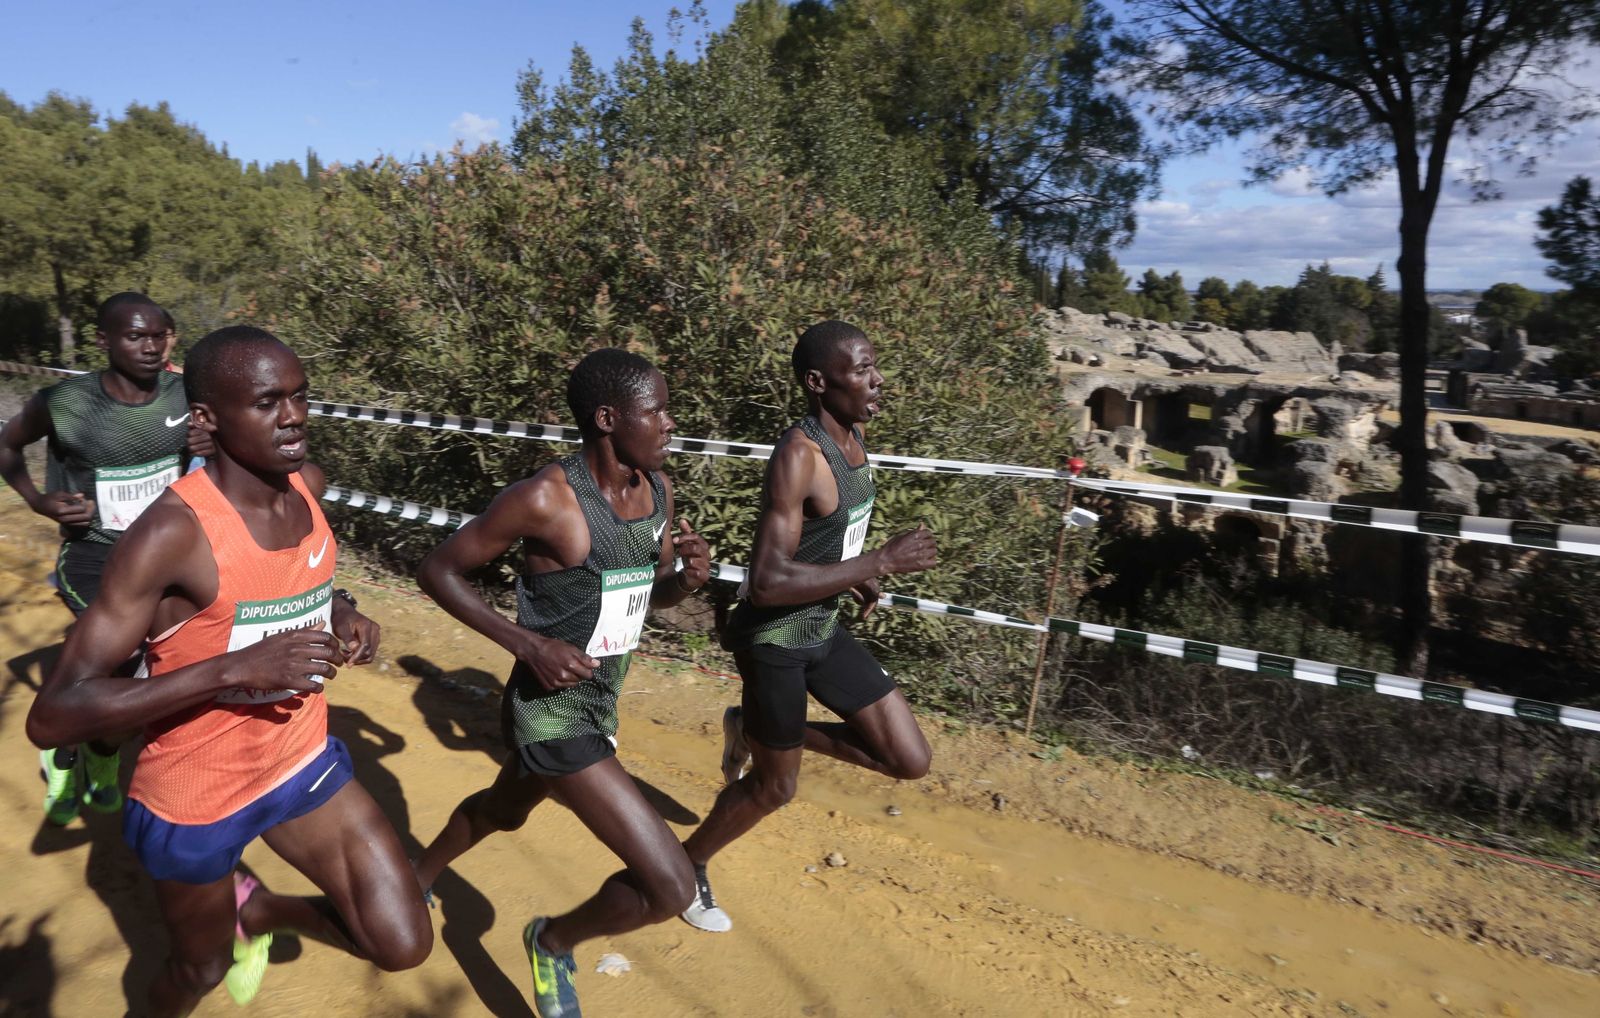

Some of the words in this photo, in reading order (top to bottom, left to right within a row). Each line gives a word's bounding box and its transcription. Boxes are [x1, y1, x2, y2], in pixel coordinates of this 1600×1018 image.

[605, 572, 650, 587] DIPUTACION
[649, 569, 655, 580] D
[240, 599, 305, 619] DIPUTACION
[305, 595, 315, 607] DE
